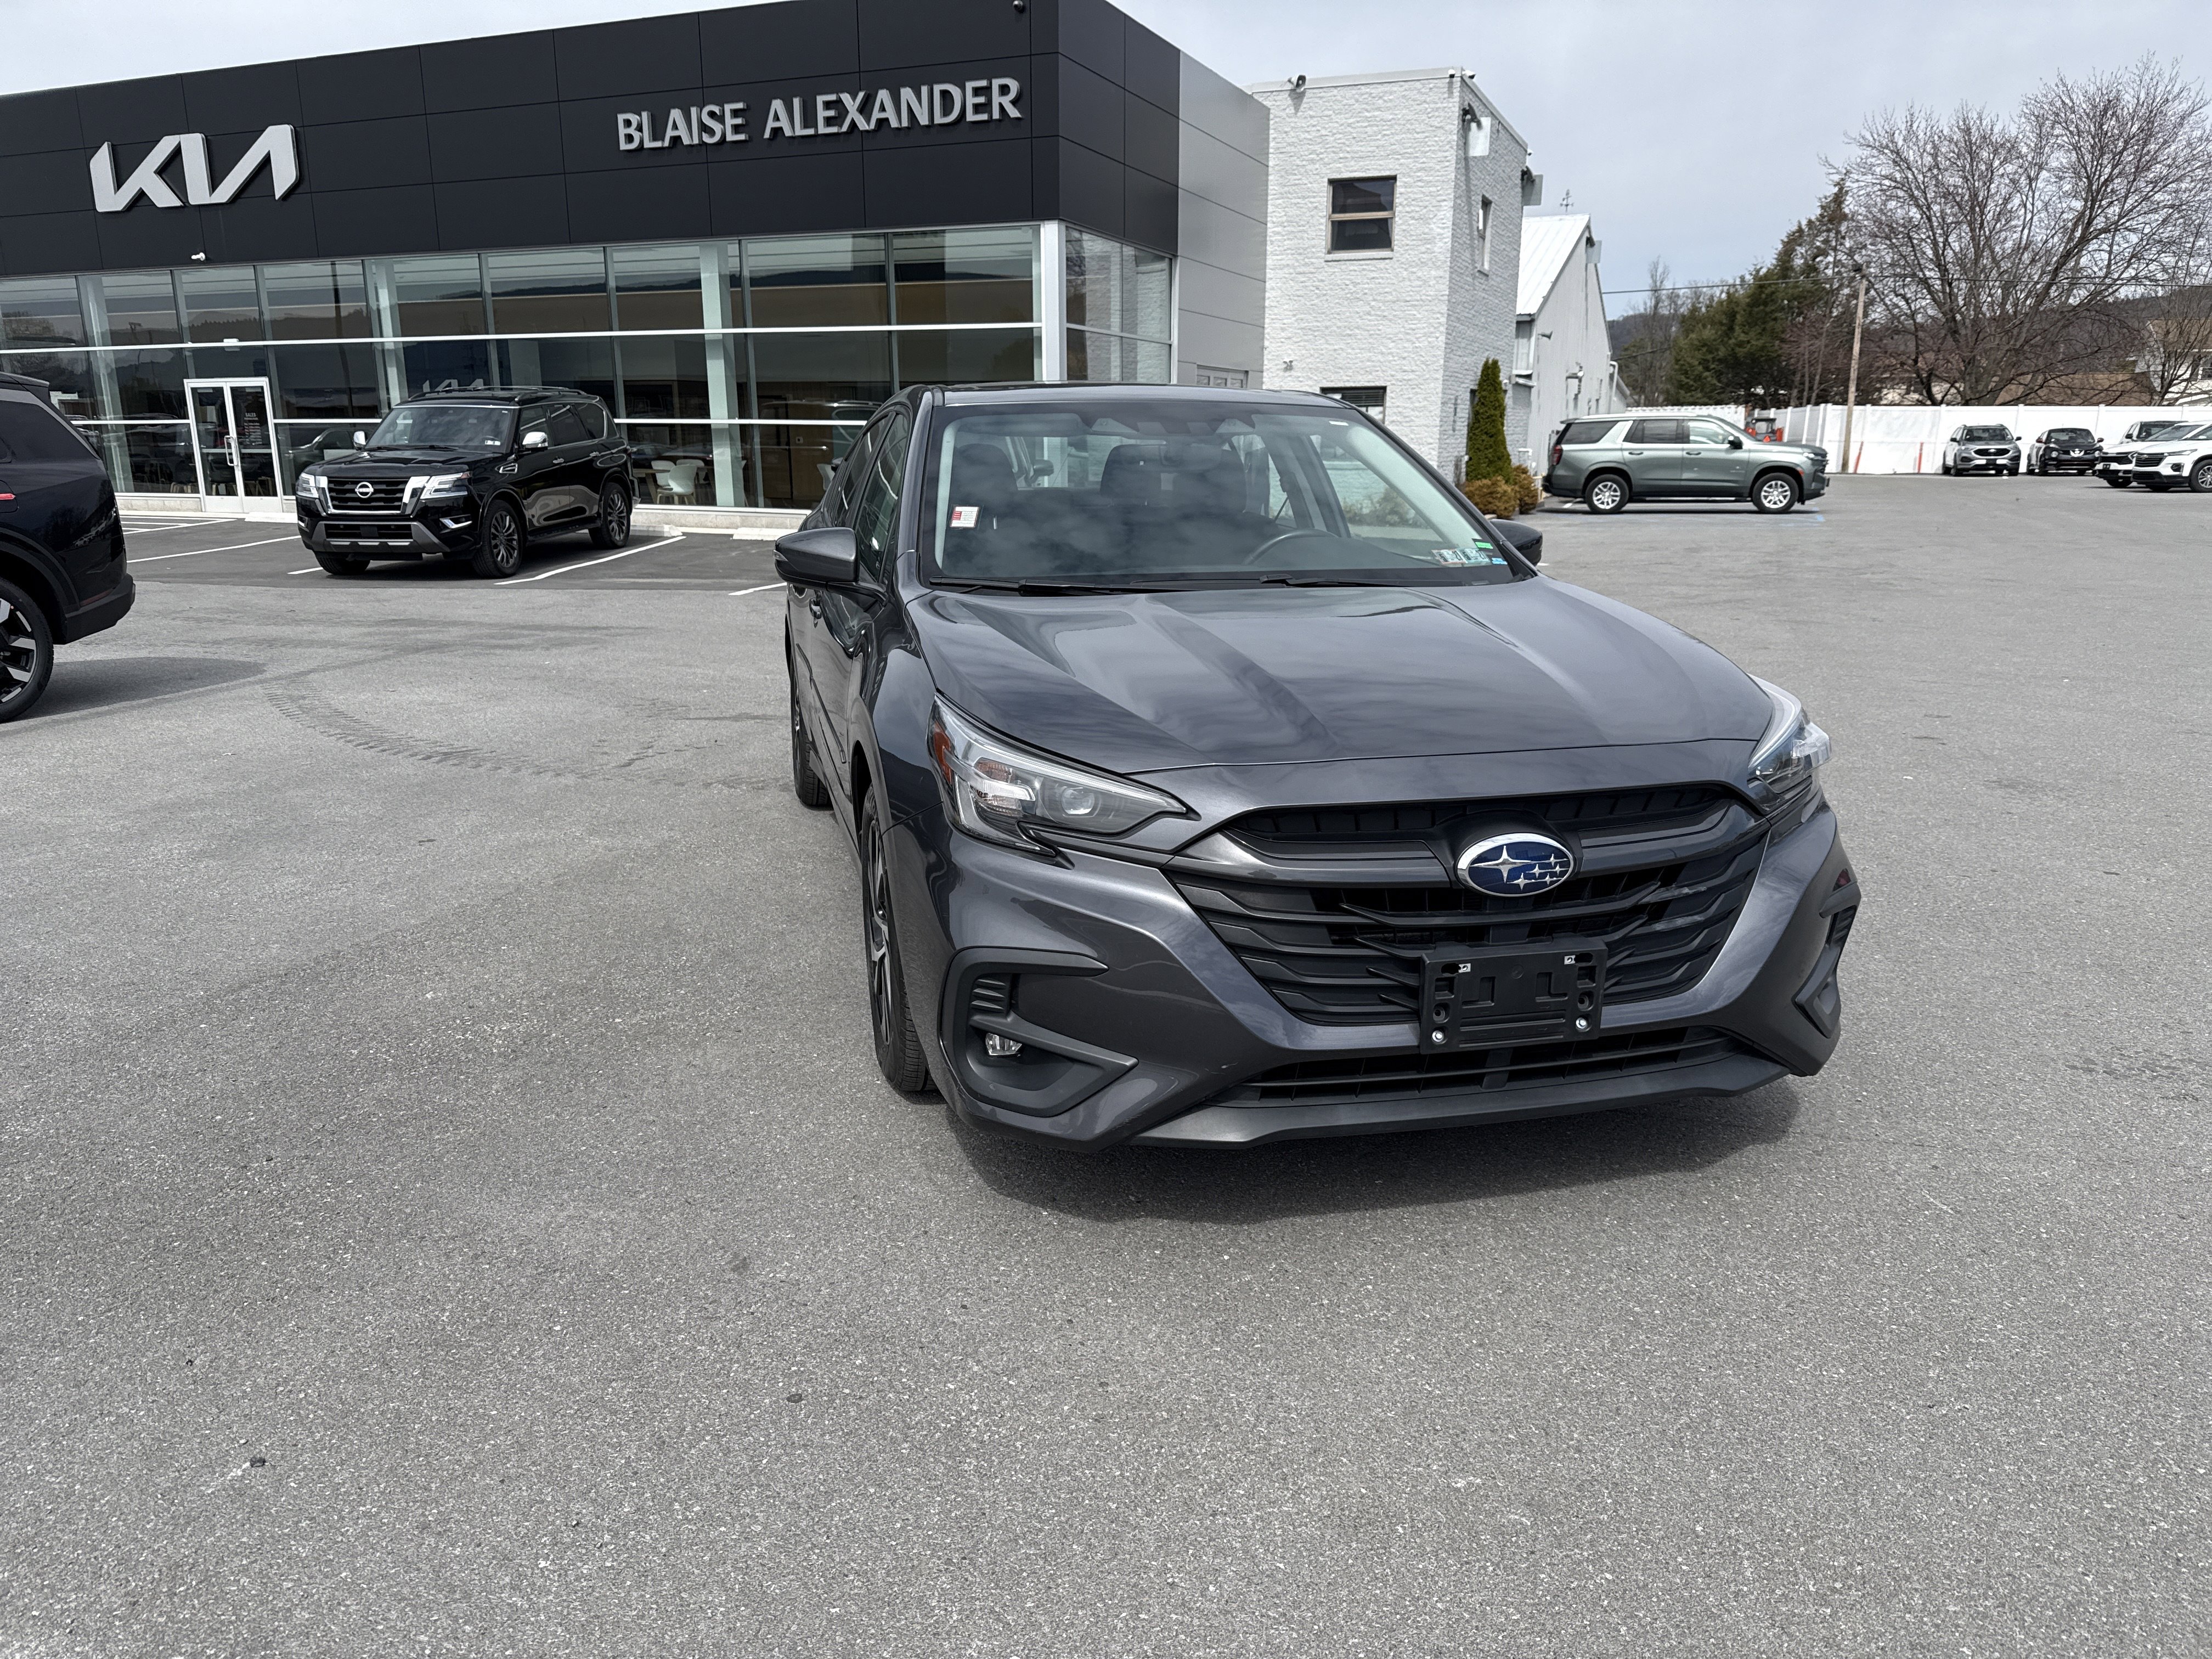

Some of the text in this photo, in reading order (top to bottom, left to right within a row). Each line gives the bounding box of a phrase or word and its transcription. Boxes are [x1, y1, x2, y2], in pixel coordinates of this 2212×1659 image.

[617, 77, 1023, 151] BLAISE ALEXANDER
[89, 124, 299, 212] KIA
